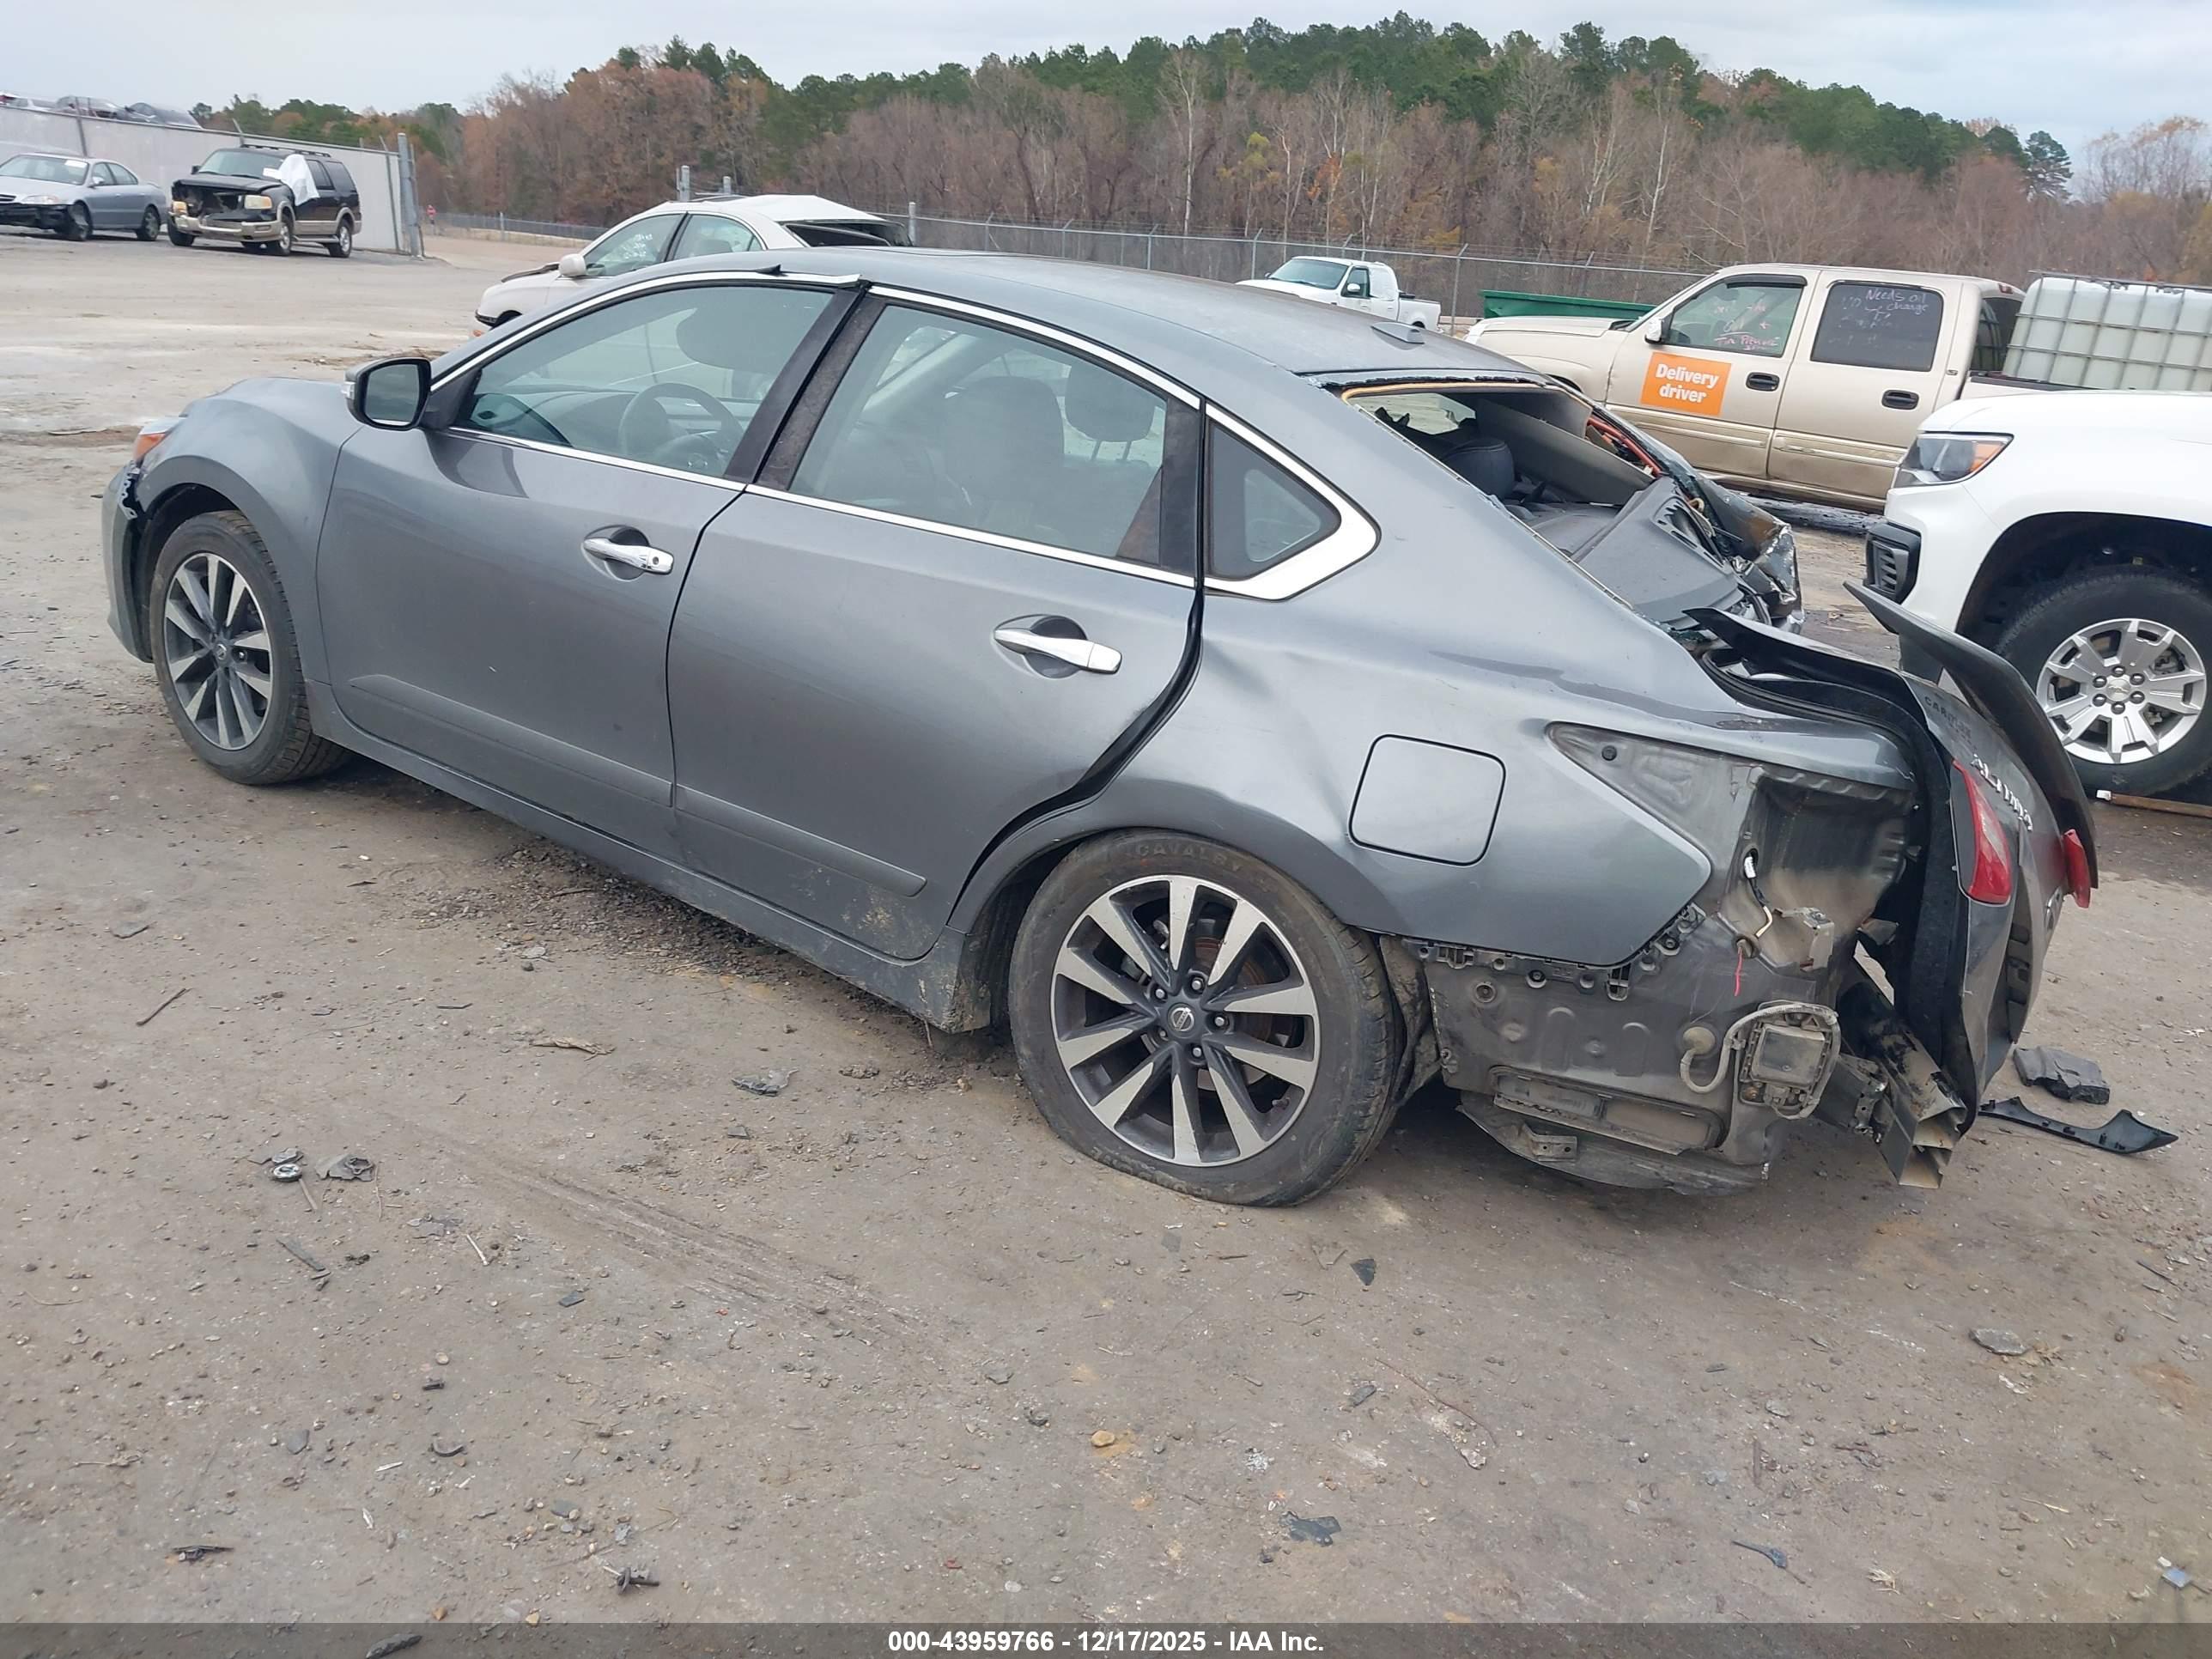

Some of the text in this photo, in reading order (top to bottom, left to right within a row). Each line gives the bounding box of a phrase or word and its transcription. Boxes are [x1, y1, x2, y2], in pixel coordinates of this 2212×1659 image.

[1656, 363, 1719, 389] Delivery
[1659, 383, 1707, 404] driver
[1135, 843, 1244, 872] CAVALRY
